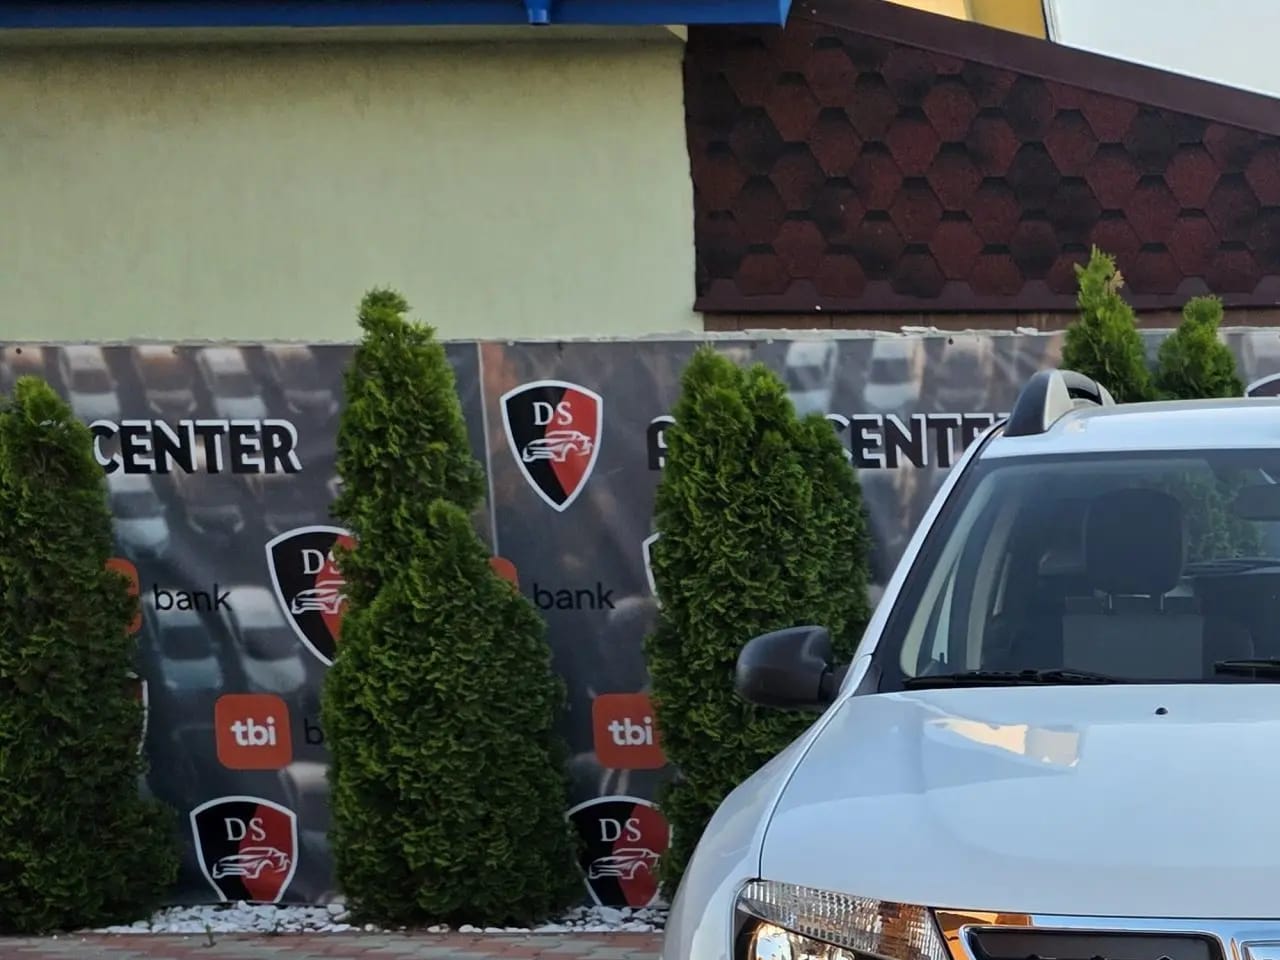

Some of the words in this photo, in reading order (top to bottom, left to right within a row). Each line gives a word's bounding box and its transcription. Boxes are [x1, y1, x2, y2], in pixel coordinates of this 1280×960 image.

[533, 401, 573, 426] DS
[91, 419, 303, 474] CENTER
[154, 583, 232, 611] bank
[533, 583, 615, 609] bank
[231, 716, 276, 745] tbi
[608, 716, 653, 745] tbi
[226, 818, 266, 841] DS
[600, 818, 640, 841] DS
